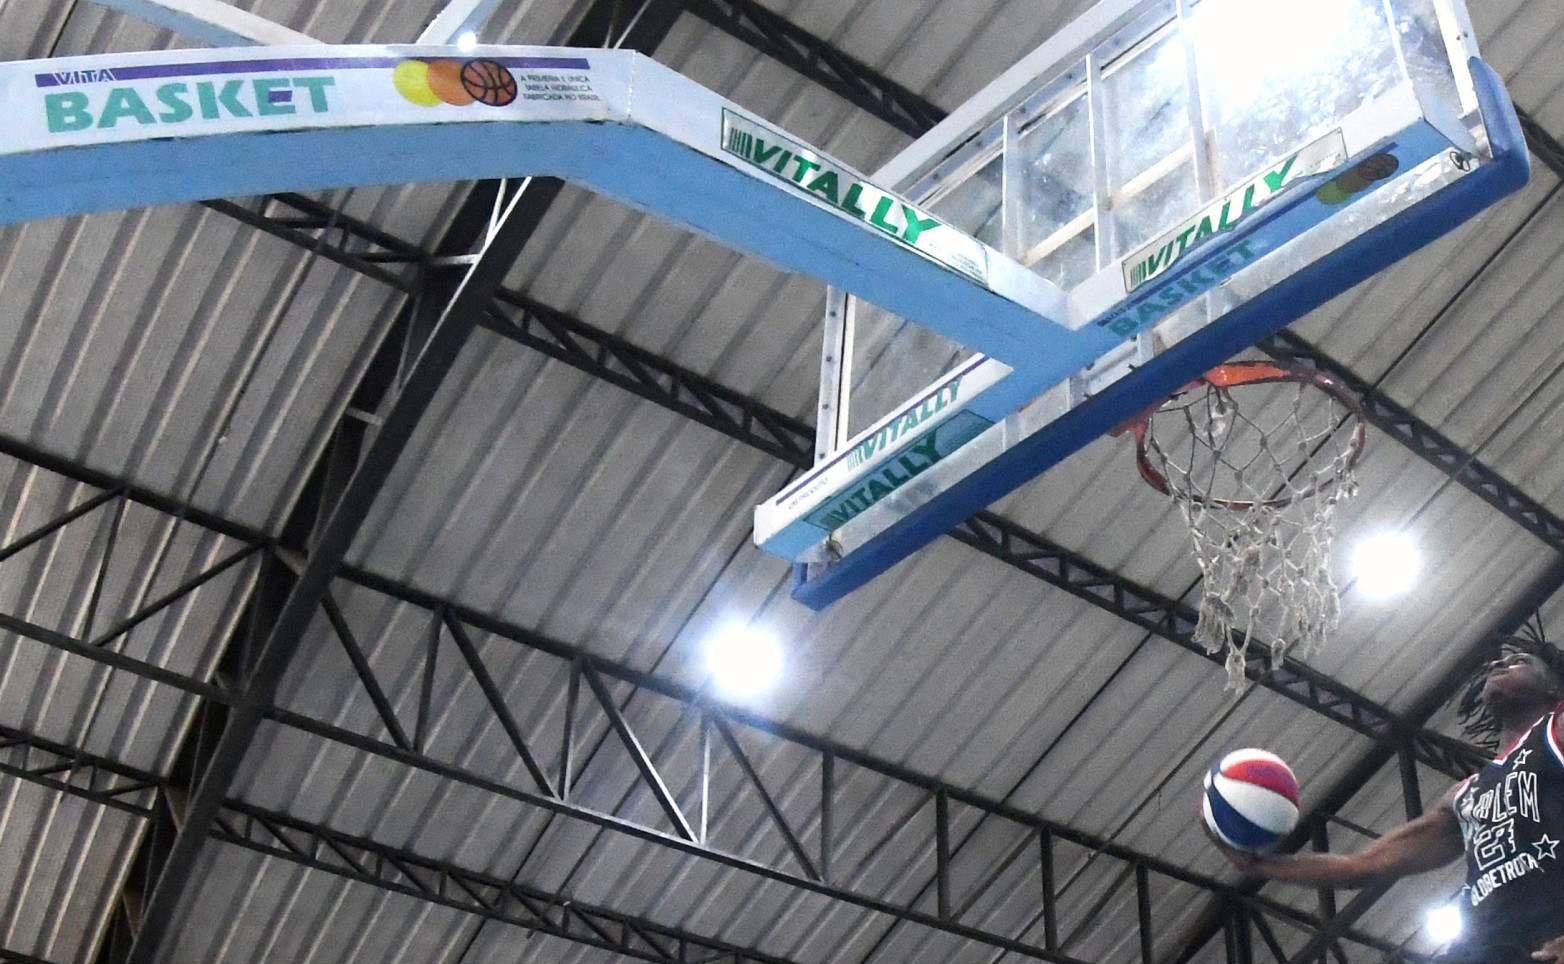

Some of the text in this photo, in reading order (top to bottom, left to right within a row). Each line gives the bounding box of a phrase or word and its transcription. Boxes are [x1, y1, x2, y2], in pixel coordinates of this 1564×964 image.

[44, 76, 336, 133] BASKET
[753, 137, 942, 244] VITALLY
[1145, 154, 1298, 277] VITALLY
[1108, 241, 1254, 336] BASKET
[861, 375, 964, 460] VITALLY
[829, 429, 942, 522] VITALLY
